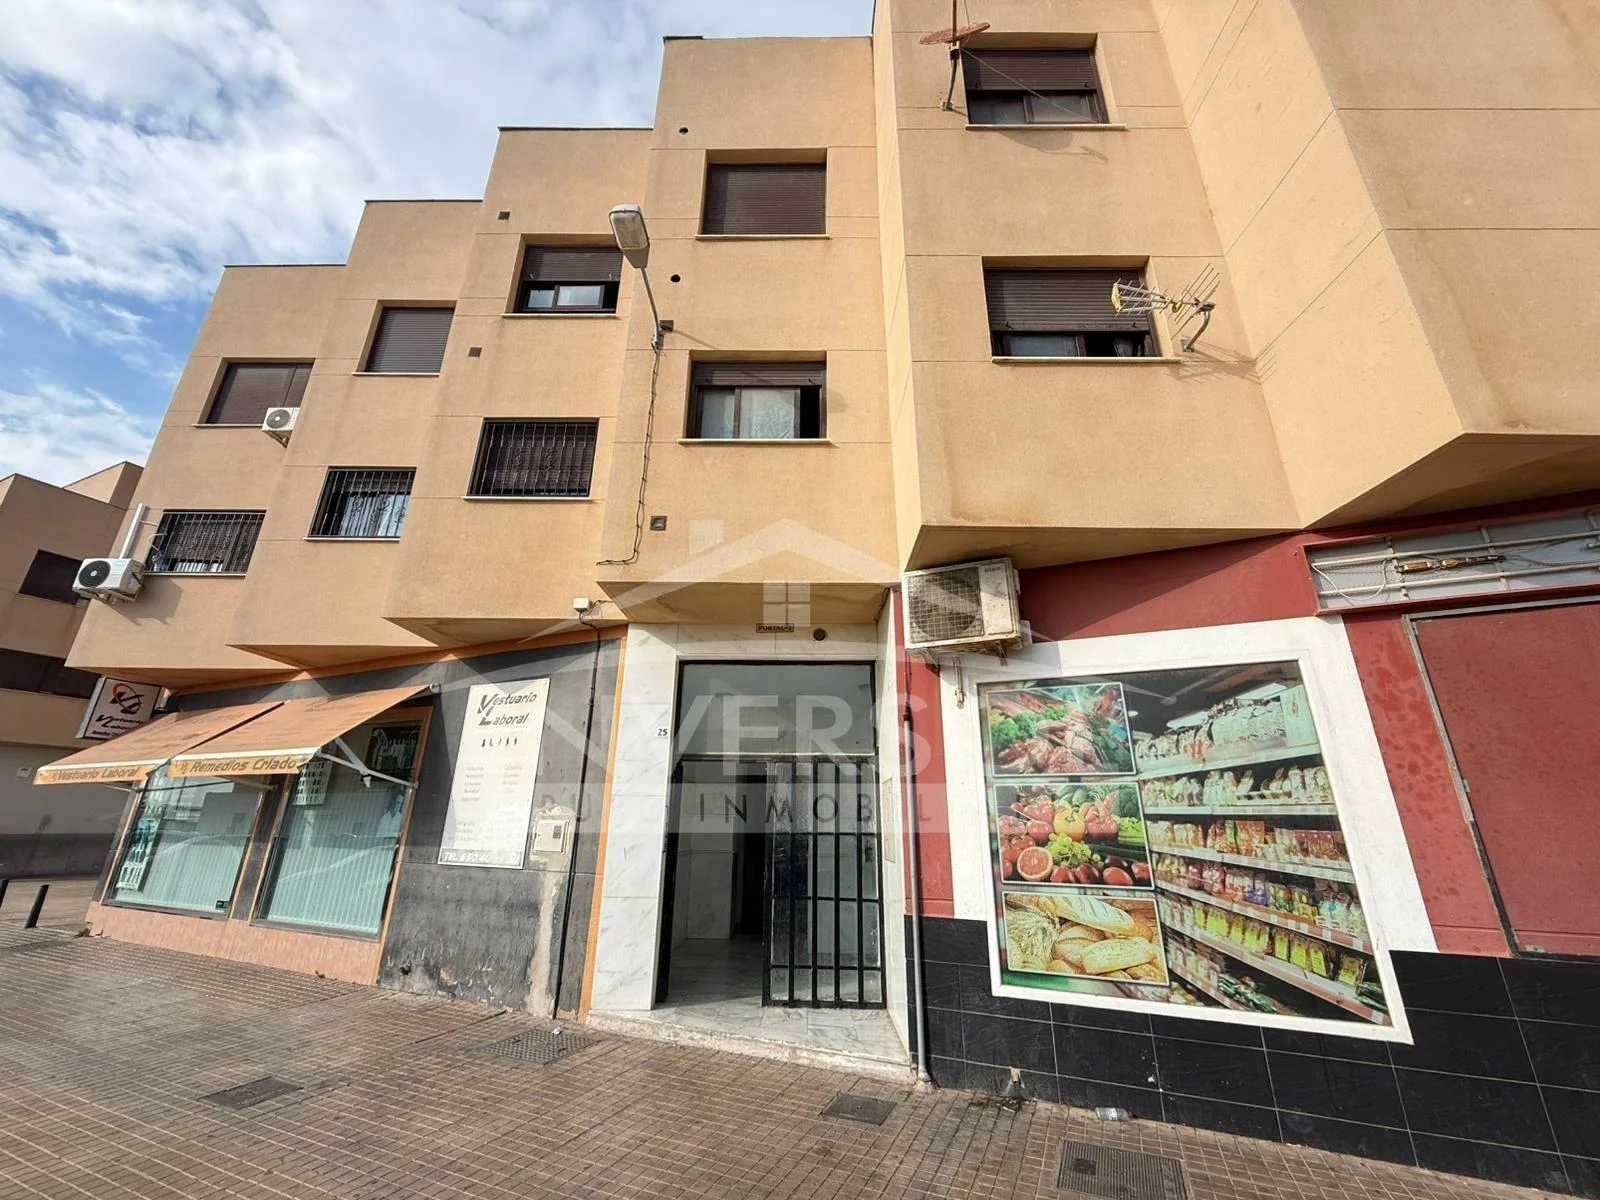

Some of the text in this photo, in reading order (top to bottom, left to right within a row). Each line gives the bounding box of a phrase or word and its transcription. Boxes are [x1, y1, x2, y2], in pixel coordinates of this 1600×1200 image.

[477, 692, 537, 714] Vestuario
[479, 706, 530, 726] Laboral
[656, 728, 668, 737] 25
[101, 766, 142, 779] Laboral
[190, 757, 297, 773] Remedios Criado
